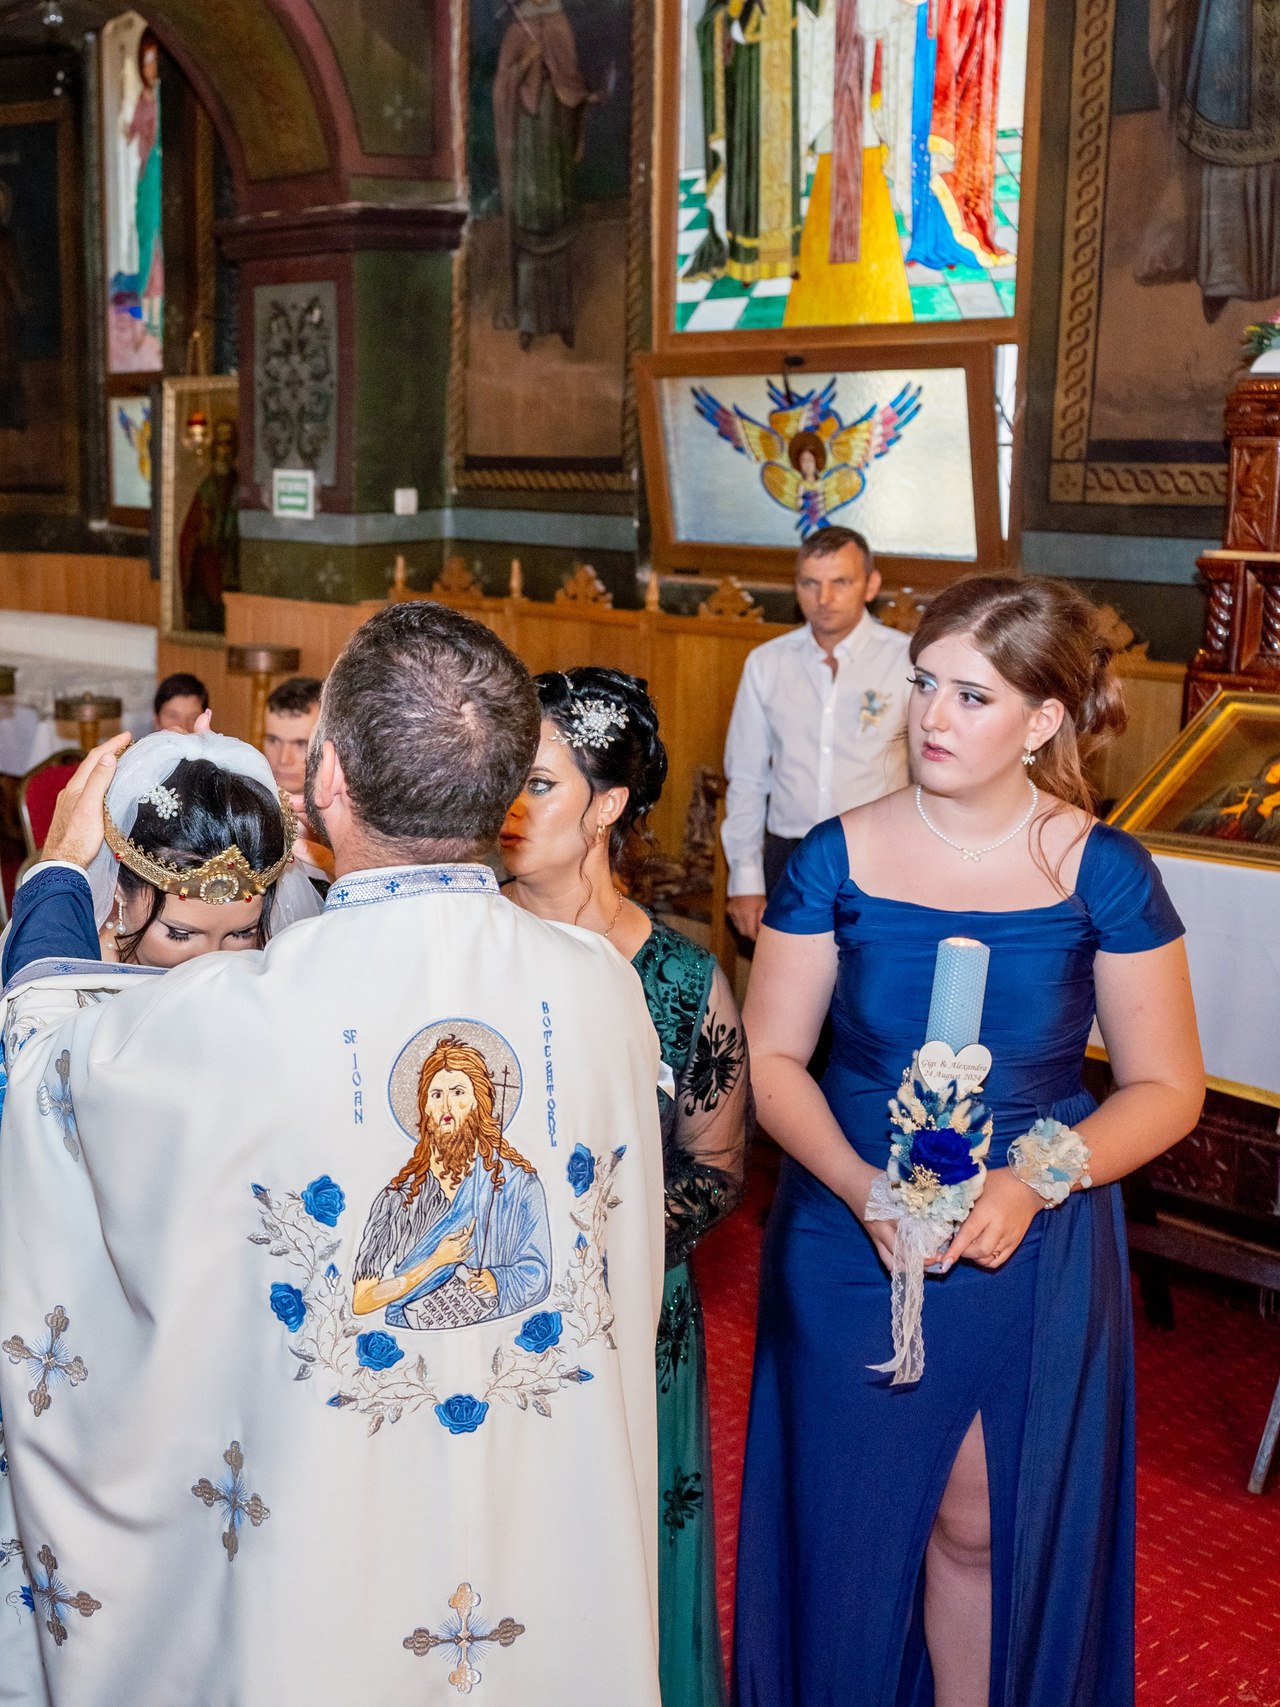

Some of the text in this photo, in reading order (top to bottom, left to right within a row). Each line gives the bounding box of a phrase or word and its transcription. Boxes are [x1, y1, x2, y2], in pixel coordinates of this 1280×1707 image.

[921, 1059, 988, 1072] Gigi & Alexandra
[933, 1070, 961, 1081] August
[963, 1073, 982, 1082] 2024
[352, 1052, 364, 1125] IOAN
[419, 1312, 435, 1329] LOR
